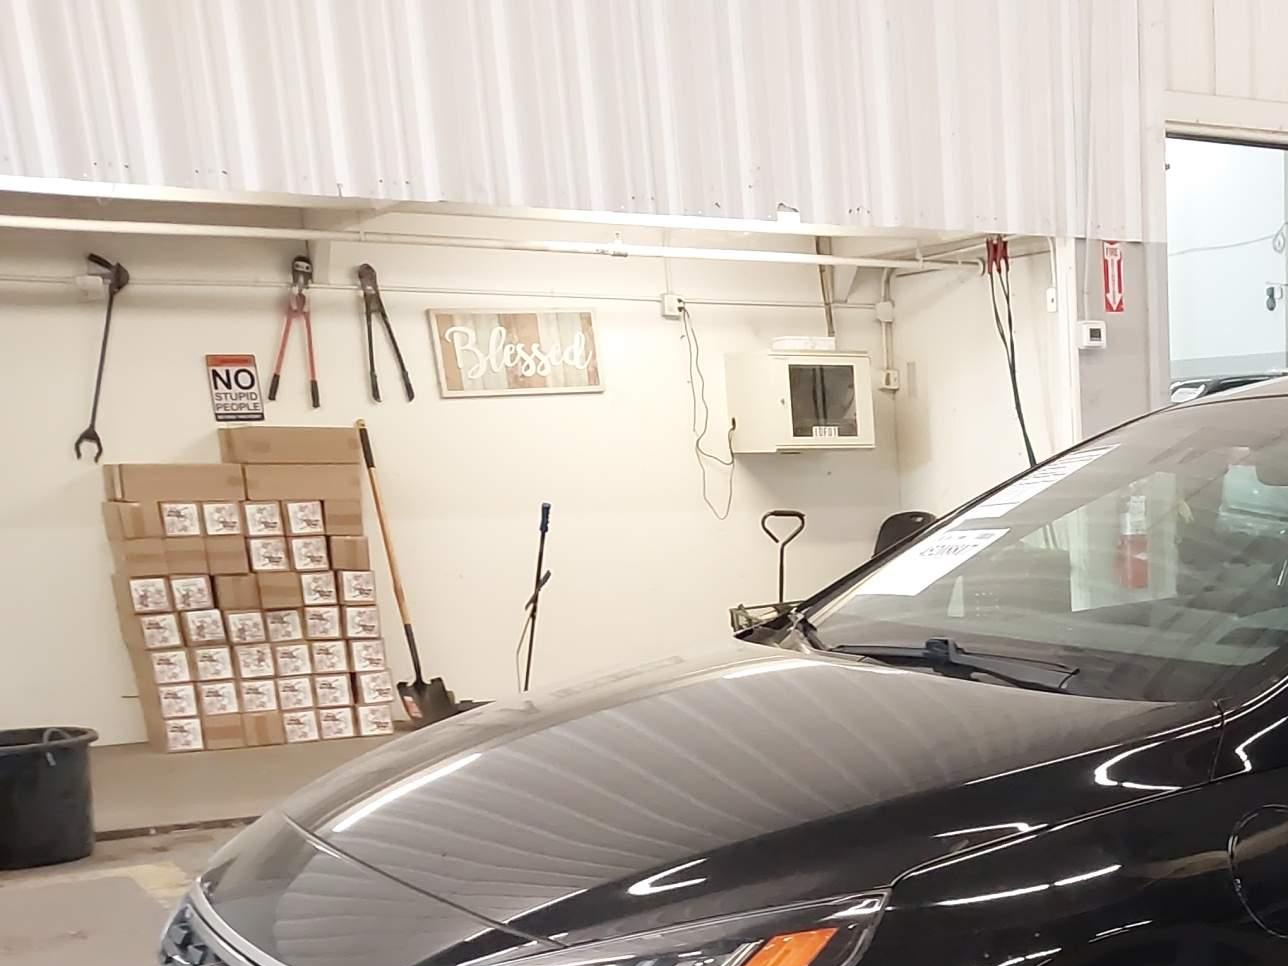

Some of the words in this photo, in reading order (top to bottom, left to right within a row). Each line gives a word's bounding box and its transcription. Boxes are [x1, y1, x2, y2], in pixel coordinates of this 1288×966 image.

[444, 326, 593, 379] Blessed
[212, 368, 255, 390] NO
[215, 392, 258, 401] STUPID
[215, 402, 261, 411] PEOPLE
